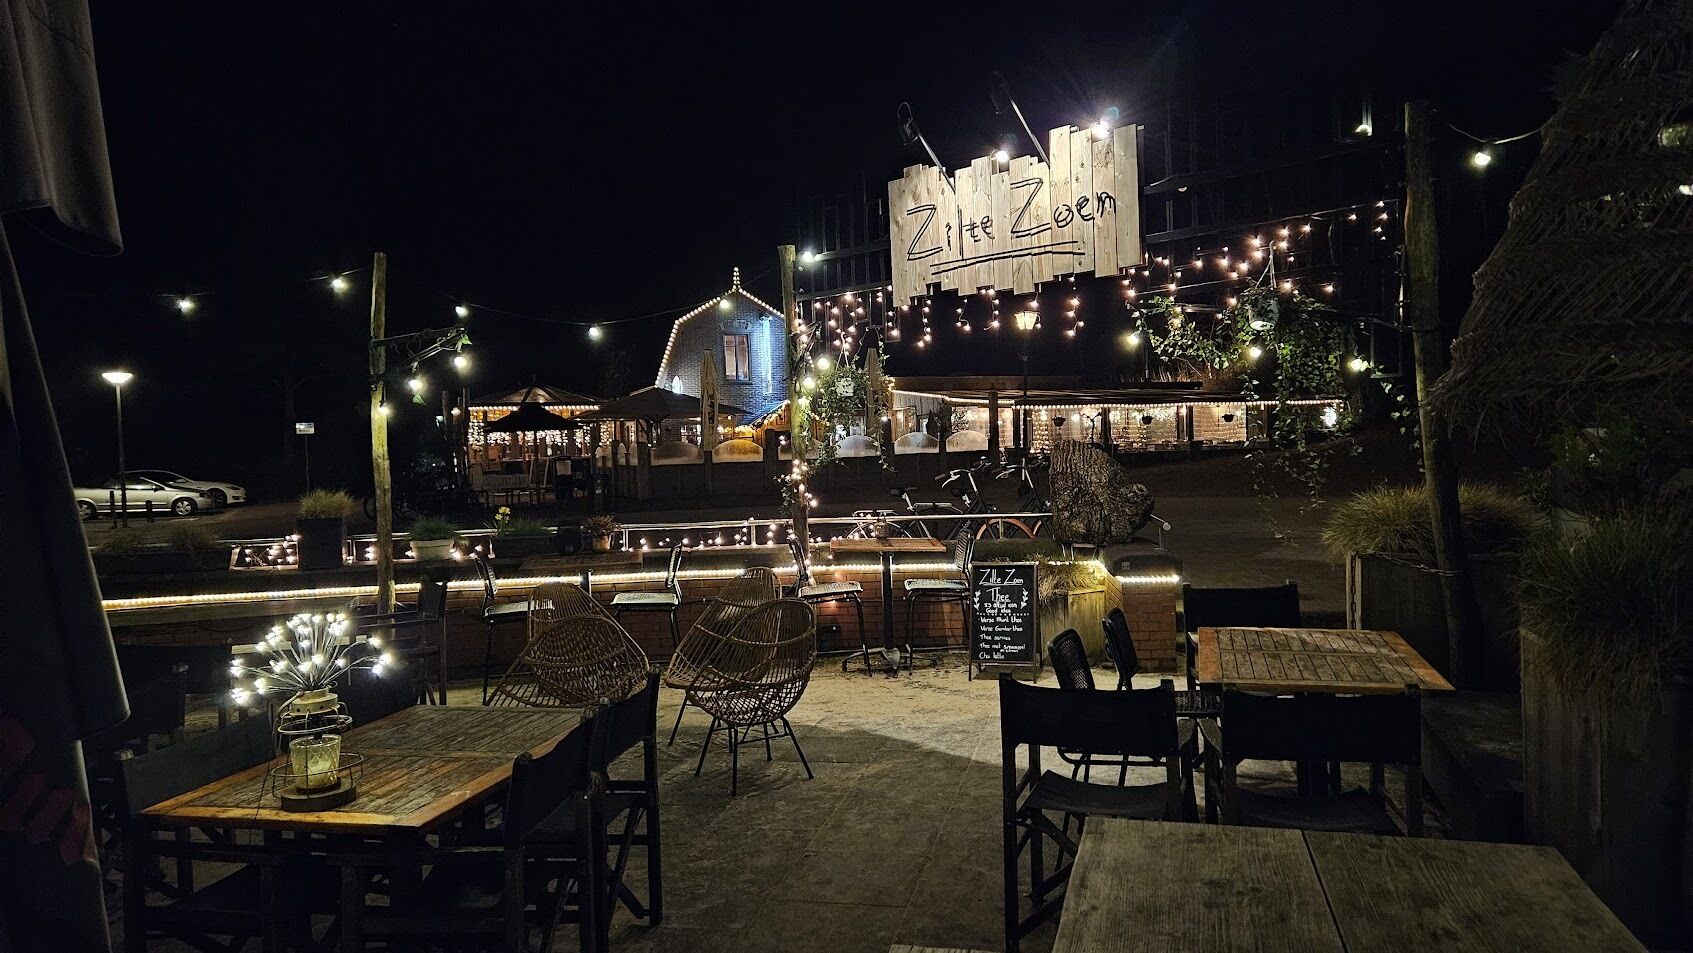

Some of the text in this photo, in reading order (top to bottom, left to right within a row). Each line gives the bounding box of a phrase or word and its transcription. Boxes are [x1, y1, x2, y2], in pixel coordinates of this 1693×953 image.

[907, 178, 1116, 261] Zilte Zoen
[986, 587, 1011, 602] Thee
